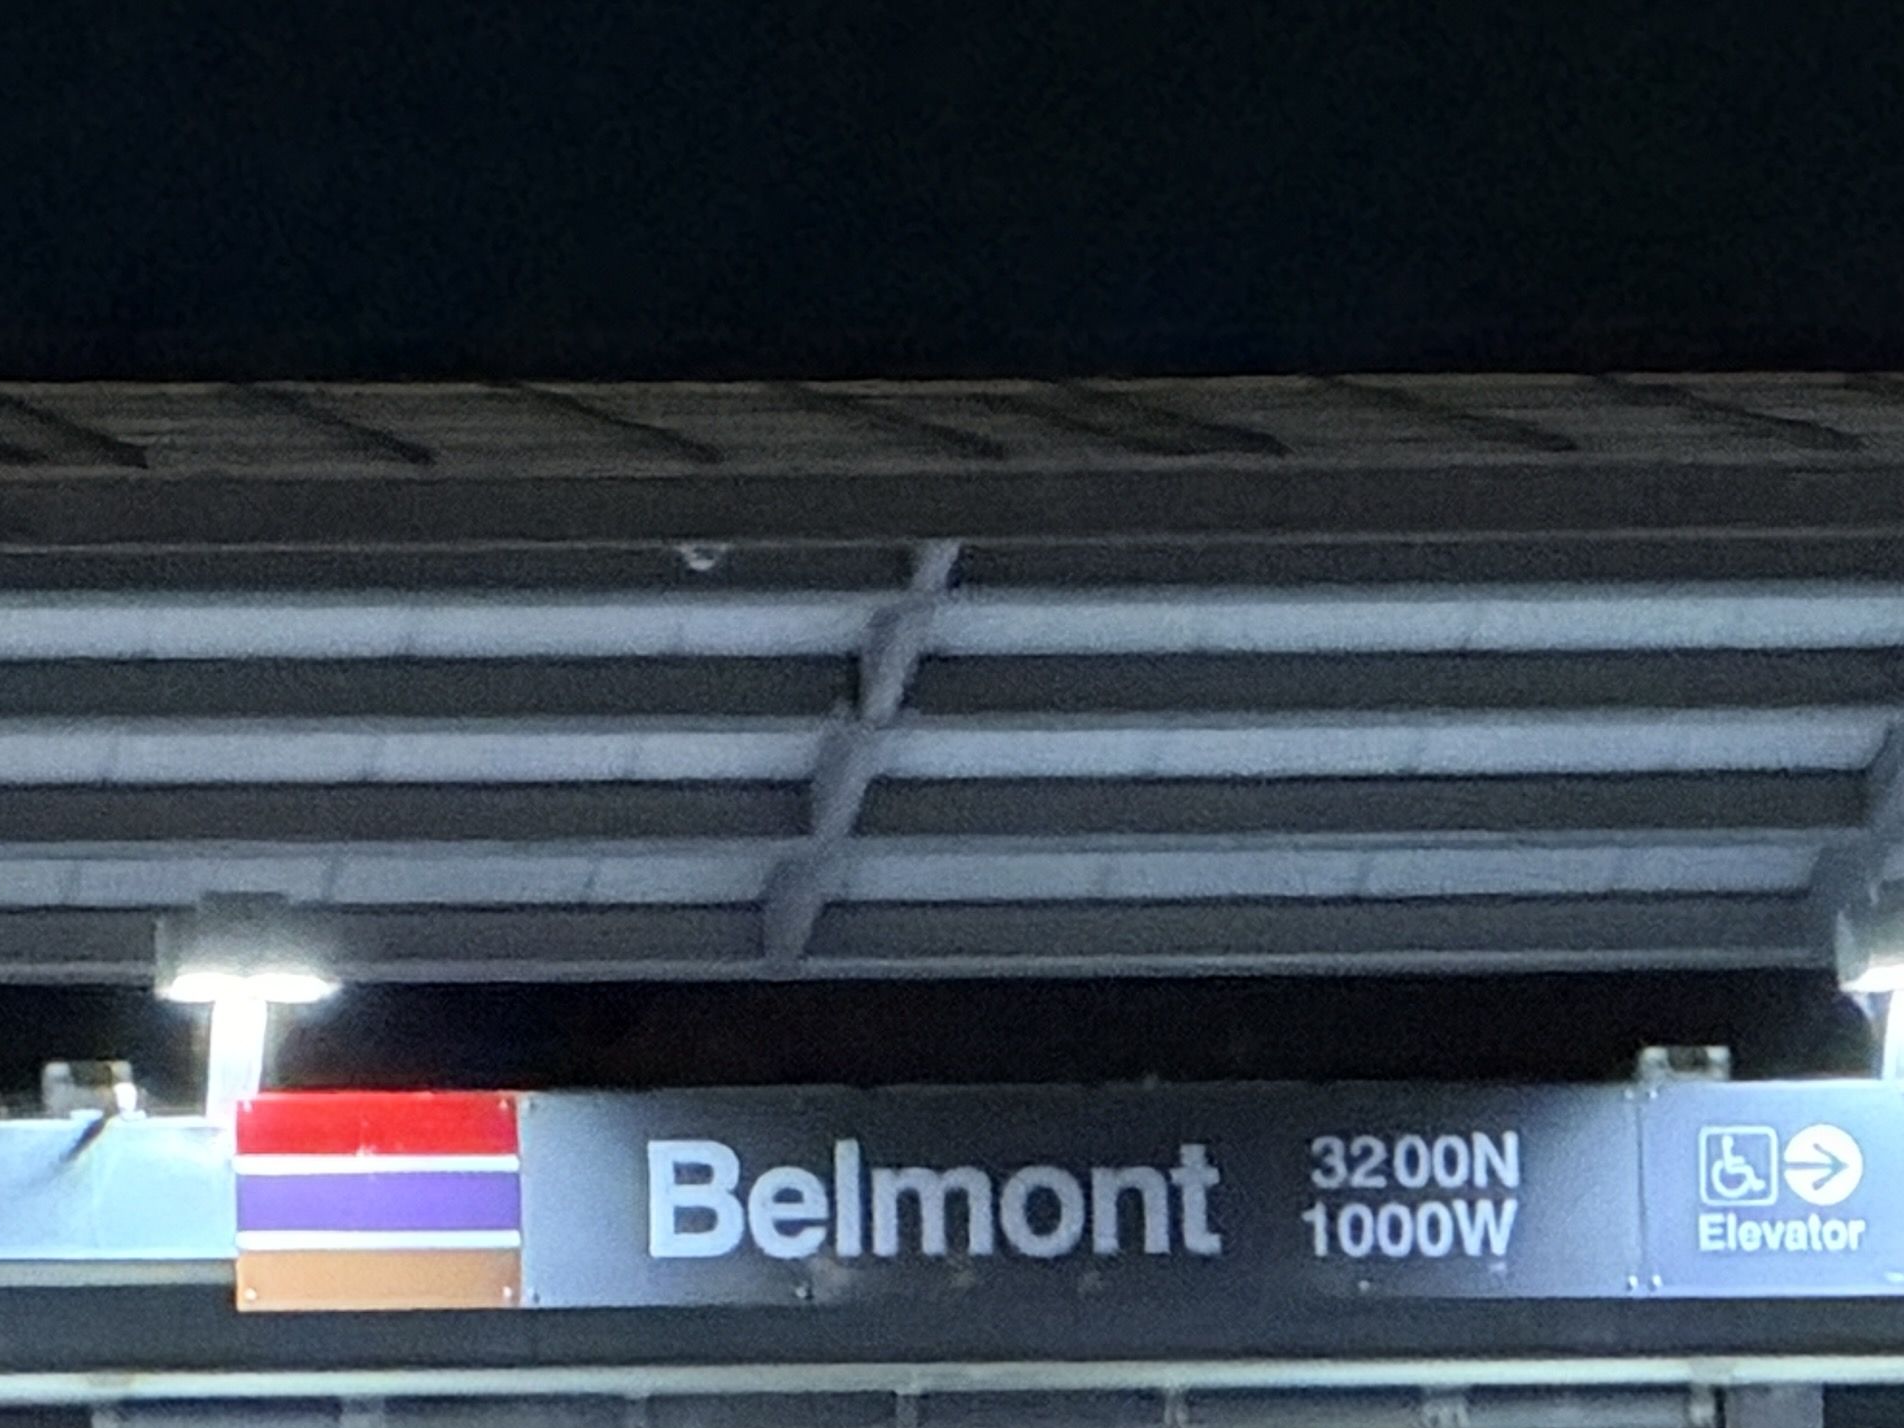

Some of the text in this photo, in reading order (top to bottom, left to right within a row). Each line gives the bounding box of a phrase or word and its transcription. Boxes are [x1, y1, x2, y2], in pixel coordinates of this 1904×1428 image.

[1309, 1131, 1520, 1190] 3200N
[647, 1138, 1222, 1260] Belmont
[1301, 1200, 1519, 1259] 1000W
[1698, 1212, 1866, 1252] Elevator
